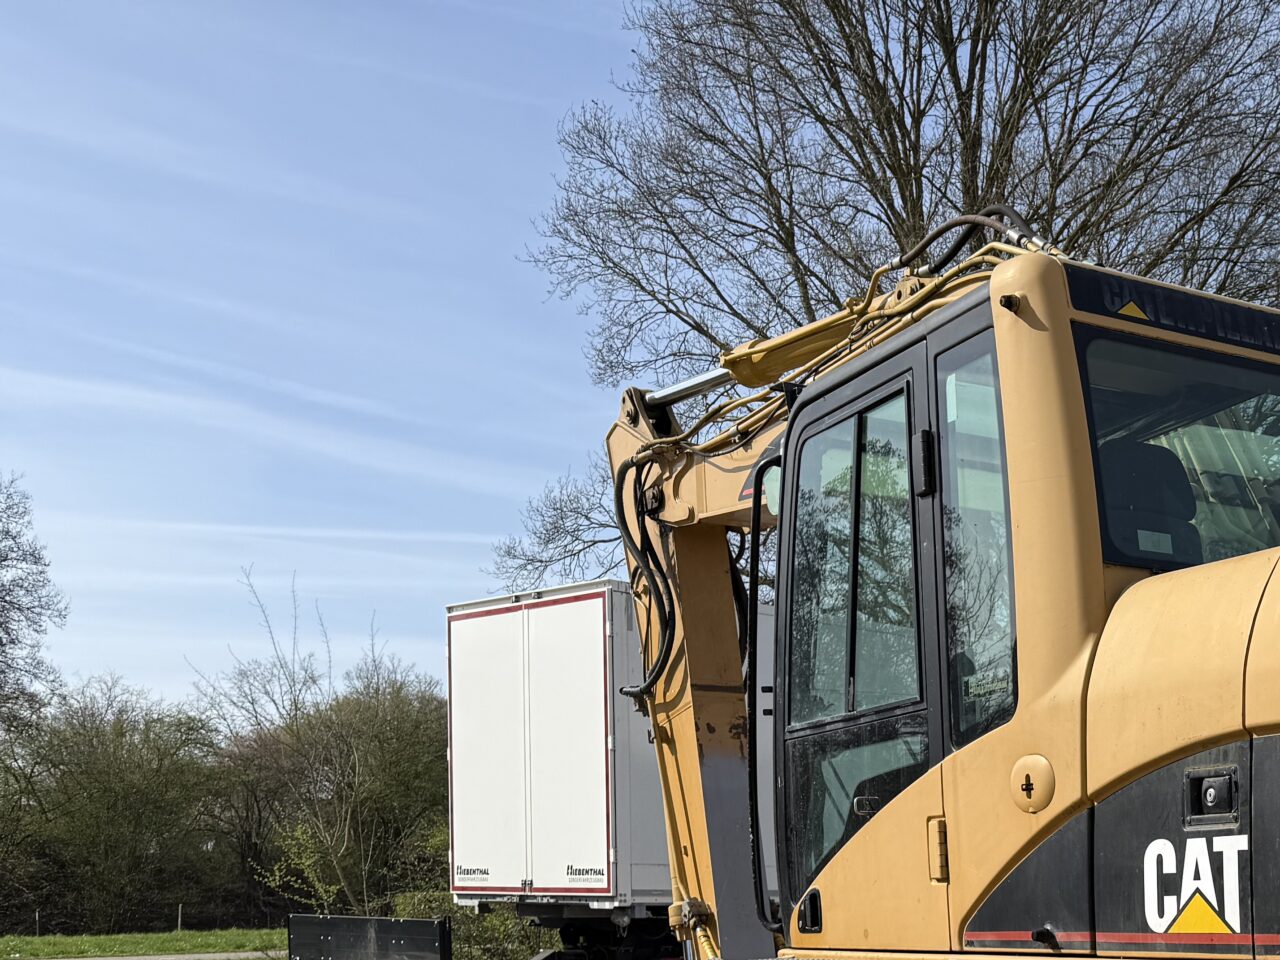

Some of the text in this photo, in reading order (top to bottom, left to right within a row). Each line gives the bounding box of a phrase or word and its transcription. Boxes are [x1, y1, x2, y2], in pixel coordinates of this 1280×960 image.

[456, 864, 490, 876] HIEBENTHAL
[566, 864, 605, 876] HIEBENTHAL
[1143, 834, 1248, 934] CAT
